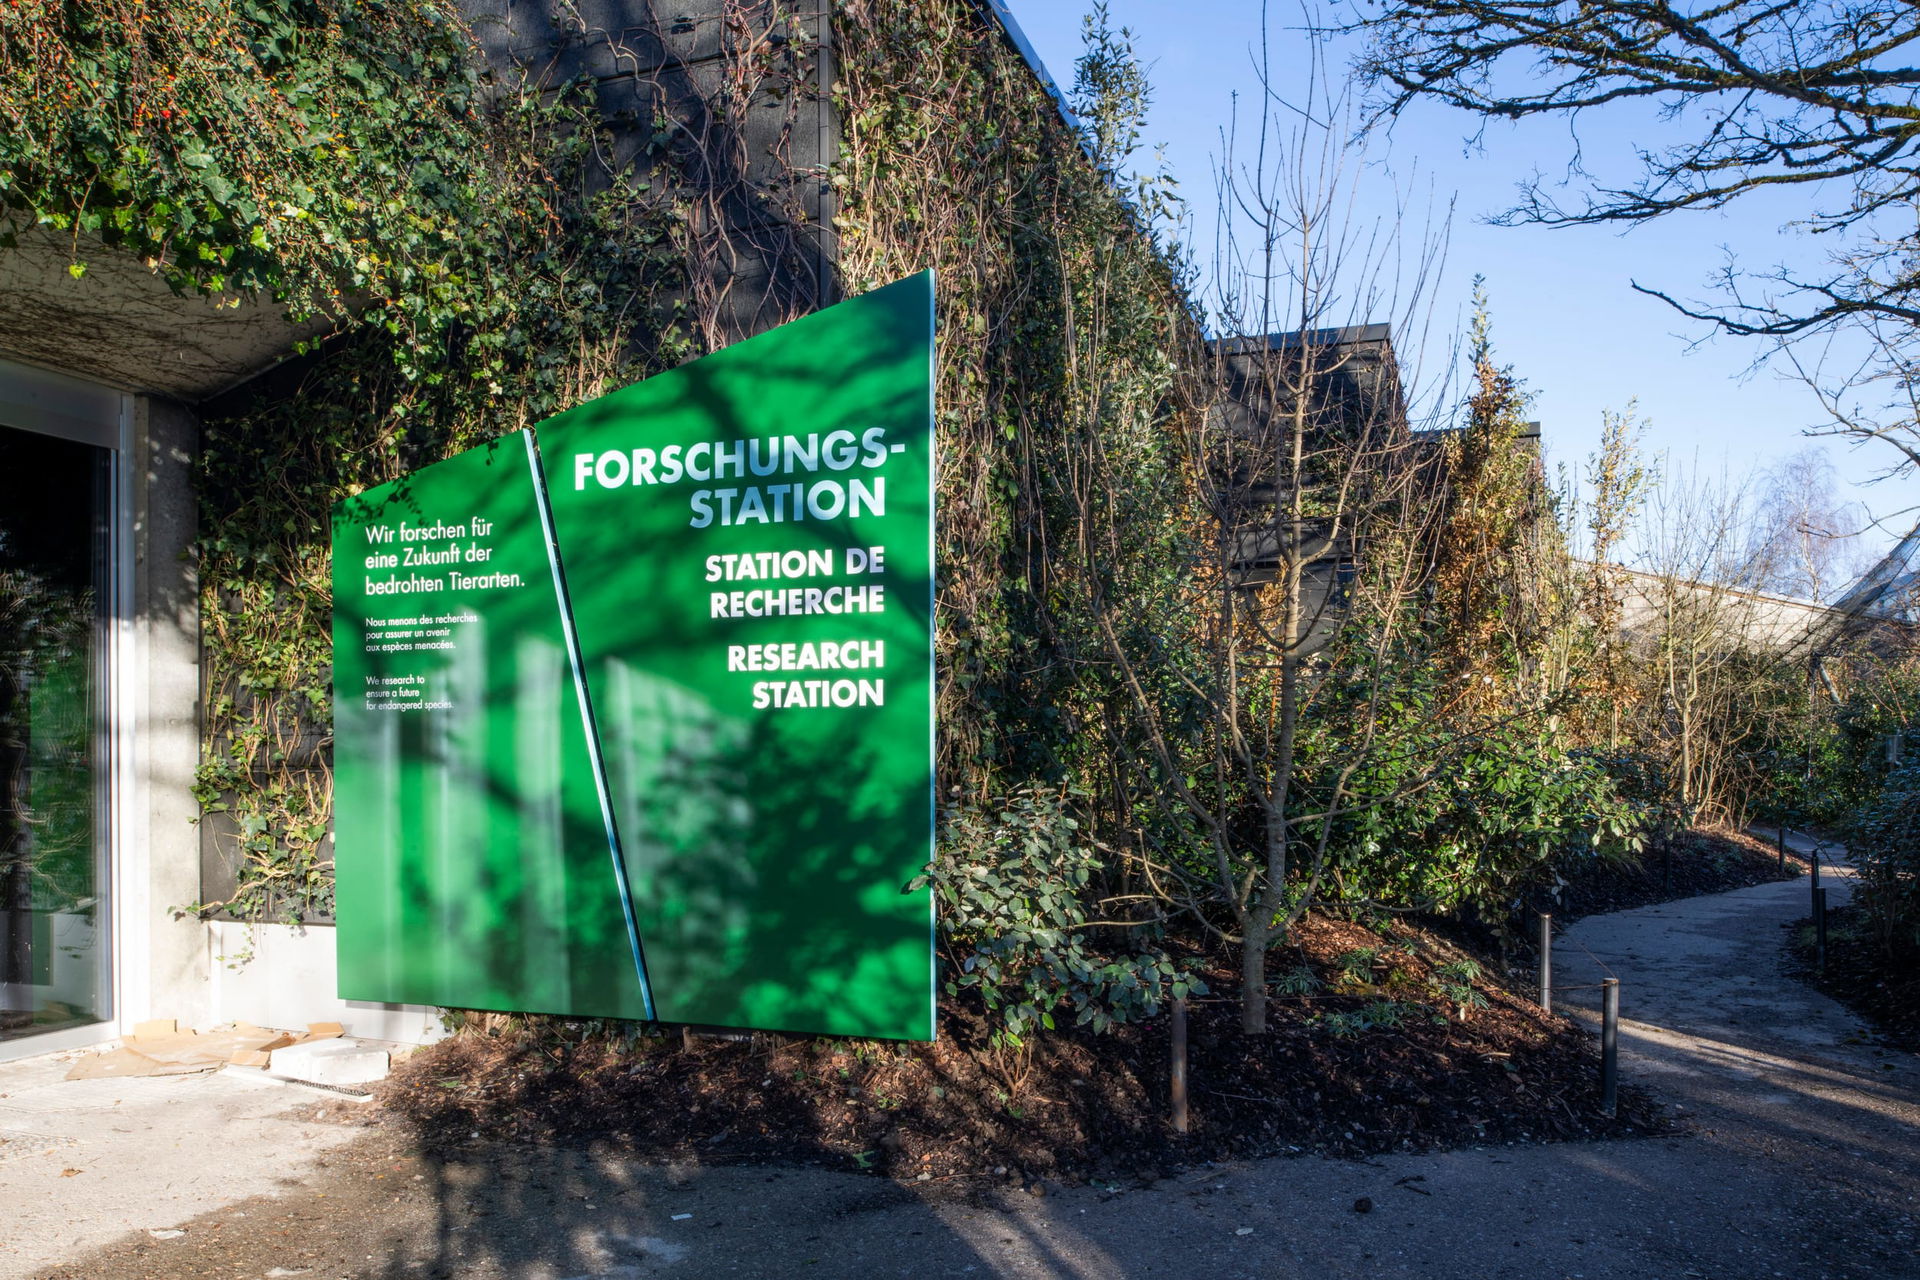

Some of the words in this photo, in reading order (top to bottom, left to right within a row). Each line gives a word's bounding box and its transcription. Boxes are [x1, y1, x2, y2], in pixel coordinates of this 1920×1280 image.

[575, 427, 905, 491] FORSCHUNGS-
[690, 477, 885, 529] STATION
[365, 525, 395, 544] Wir
[400, 520, 465, 542] forschen
[472, 516, 493, 537] für
[365, 552, 397, 569] eine
[403, 543, 460, 567] Zukunft
[465, 542, 492, 563] der
[706, 549, 832, 582] STATION
[846, 546, 885, 575] DE
[365, 573, 443, 595] bedrohten
[449, 572, 525, 591] Tierarten.
[710, 585, 884, 619] RECHERCHE
[366, 618, 386, 627] Nous
[388, 616, 417, 626] menons
[420, 614, 433, 625] des
[435, 613, 478, 624] recherches
[366, 631, 383, 642] pour
[385, 630, 412, 639] assurer
[426, 627, 450, 637] avenir
[366, 643, 380, 652] aux
[382, 642, 412, 652] espèces
[415, 640, 456, 650] menacées.
[728, 641, 884, 672] RESEARCH
[366, 676, 380, 685] We
[382, 675, 415, 685] research
[417, 675, 424, 684] to
[366, 688, 390, 698] ensure
[399, 688, 420, 697] future
[366, 700, 376, 711] for
[378, 699, 423, 712] endangered
[752, 680, 884, 709] STATION
